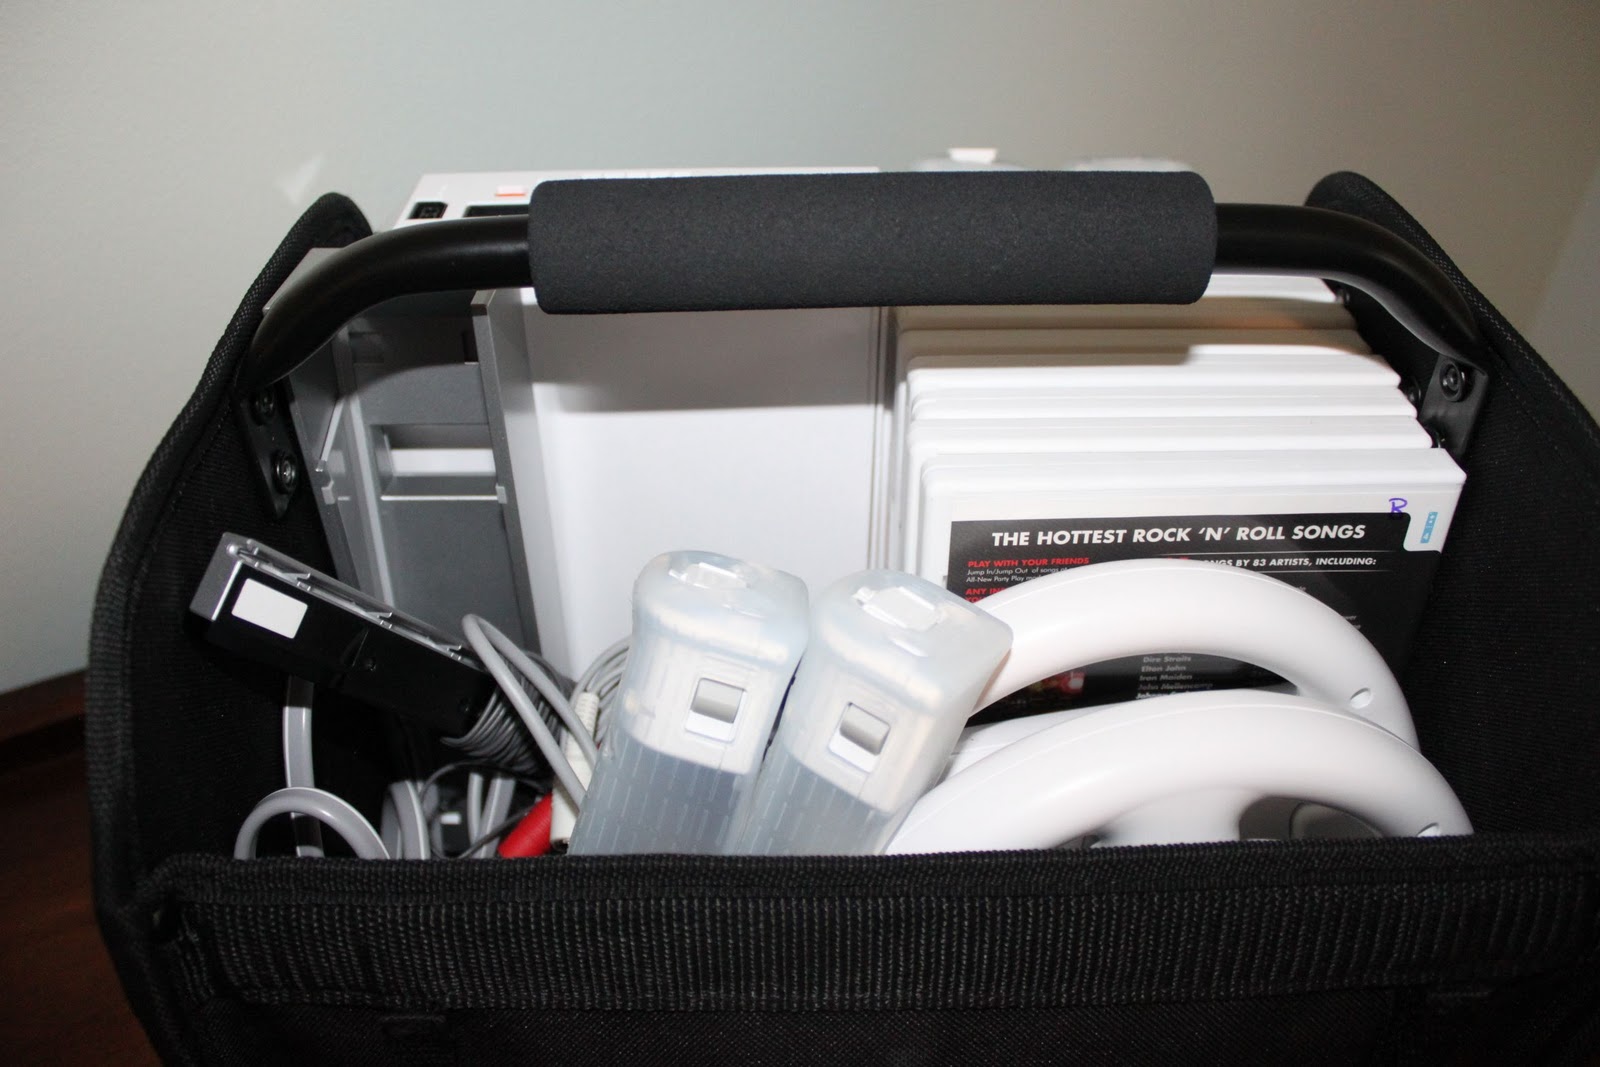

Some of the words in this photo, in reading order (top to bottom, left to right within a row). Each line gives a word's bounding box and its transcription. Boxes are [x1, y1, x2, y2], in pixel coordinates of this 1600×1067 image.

[992, 531, 1030, 546] THE
[1037, 529, 1127, 546] HOTTEST
[1132, 528, 1192, 543] ROCK
[1236, 526, 1285, 541] ROLL
[1292, 525, 1366, 540] SONGS
[967, 560, 991, 568] PLAY
[994, 559, 1018, 568] WITH
[1021, 558, 1048, 567] YOUR
[1051, 557, 1090, 566] FRIENDS
[1236, 558, 1251, 567] BY
[1252, 558, 1267, 567] 83
[1269, 558, 1312, 567] ARTISTS,
[1315, 557, 1377, 566] INCLUDING:
